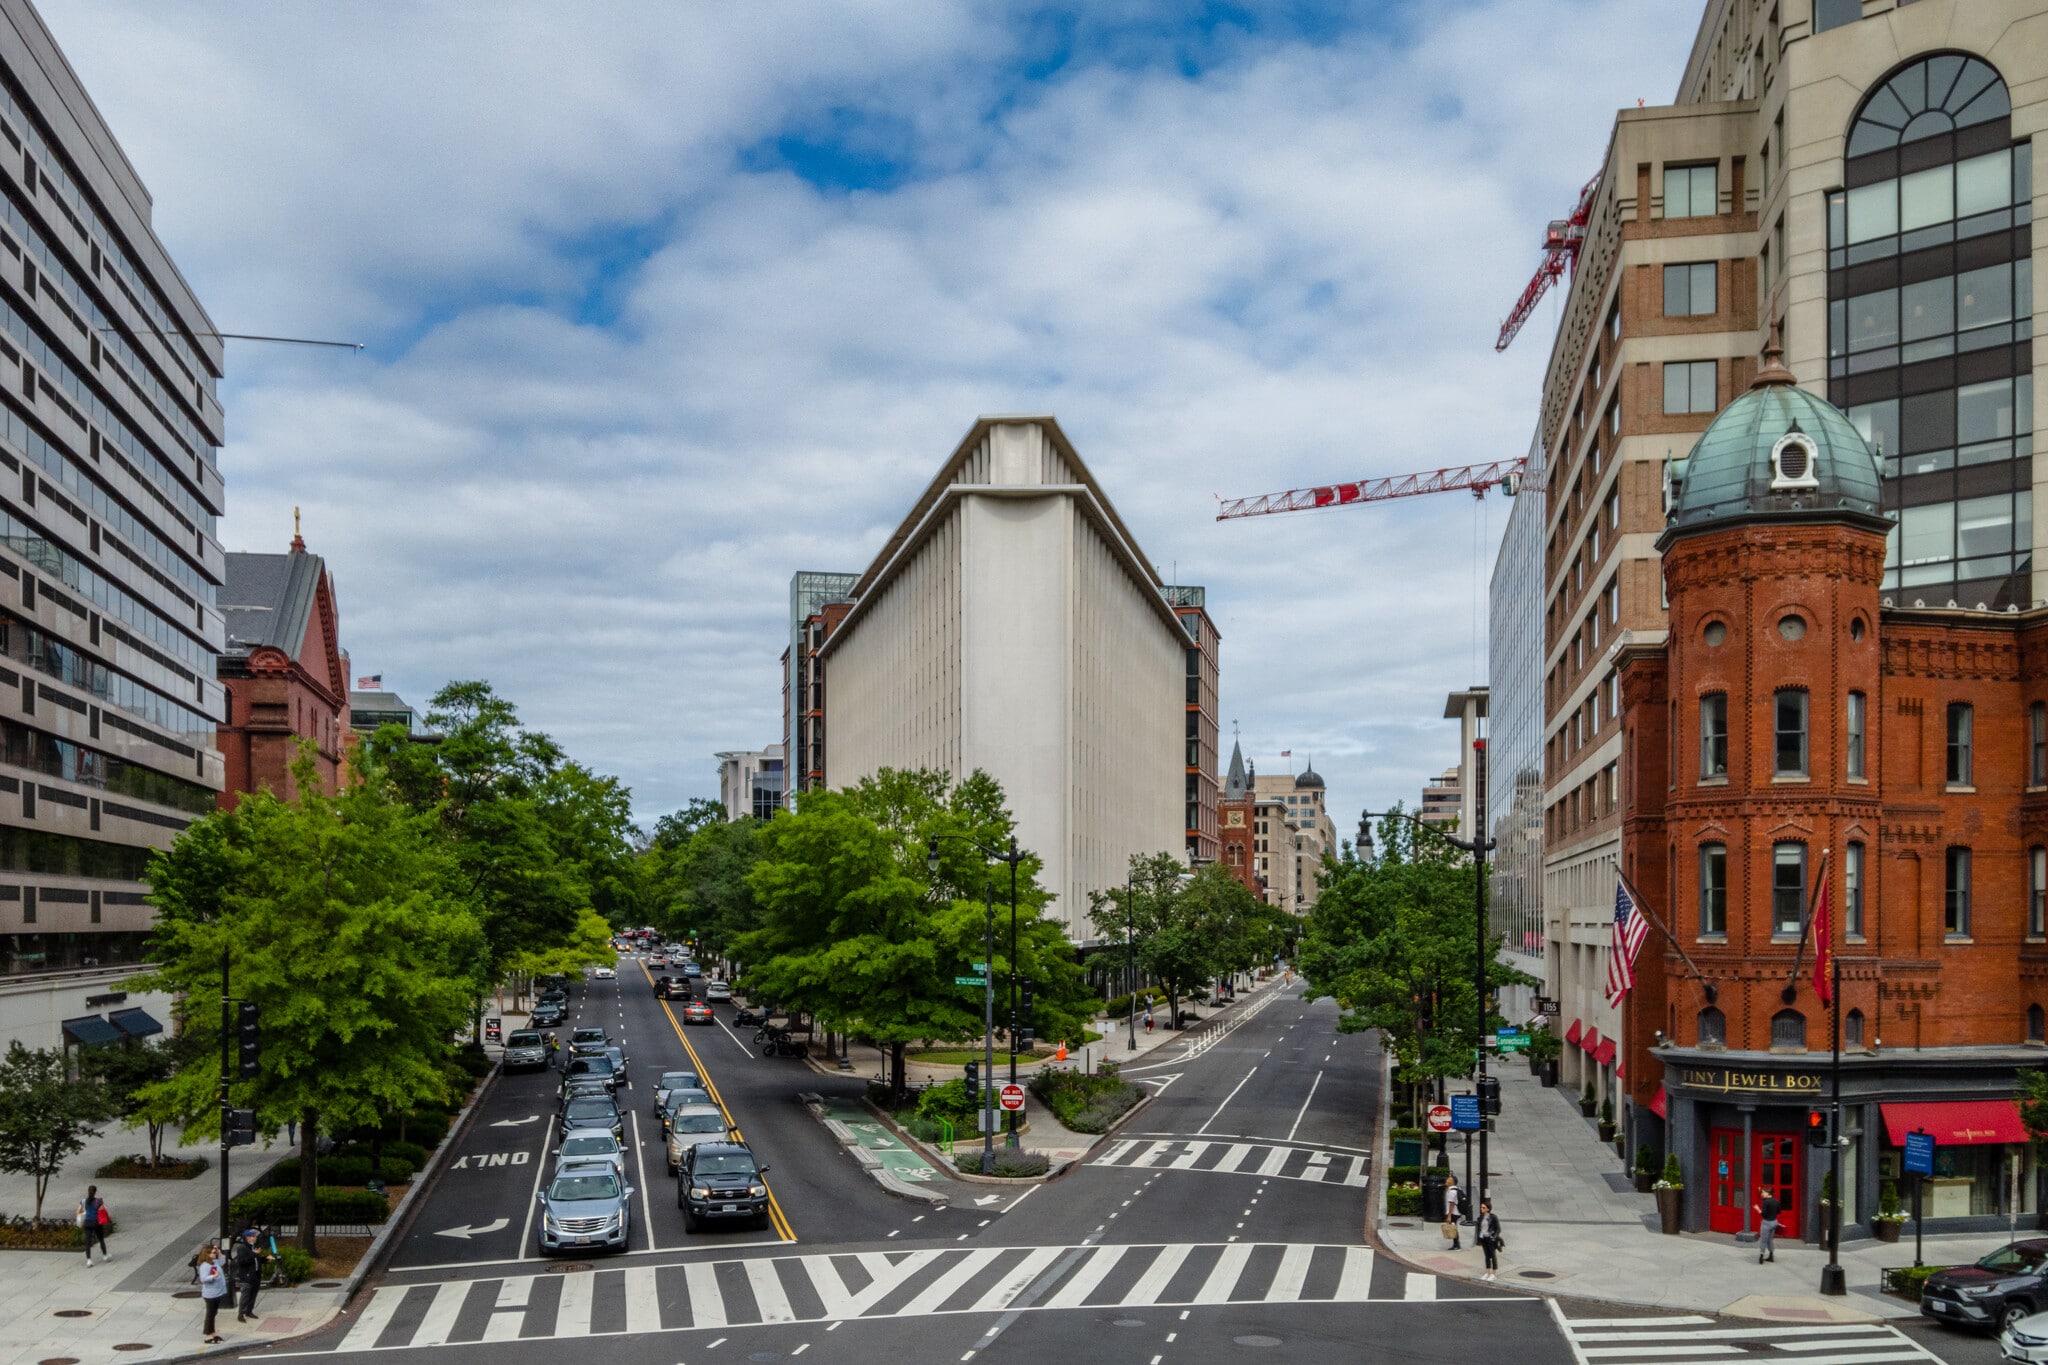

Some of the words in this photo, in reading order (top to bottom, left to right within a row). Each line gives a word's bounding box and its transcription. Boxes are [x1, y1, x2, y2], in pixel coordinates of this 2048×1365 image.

[1543, 1002, 1557, 1012] 1155
[1681, 1069, 1717, 1084] TINY
[1723, 1070, 1779, 1094] JEWEL
[1786, 1075, 1821, 1088] BOX
[450, 1151, 530, 1170] ONLY
